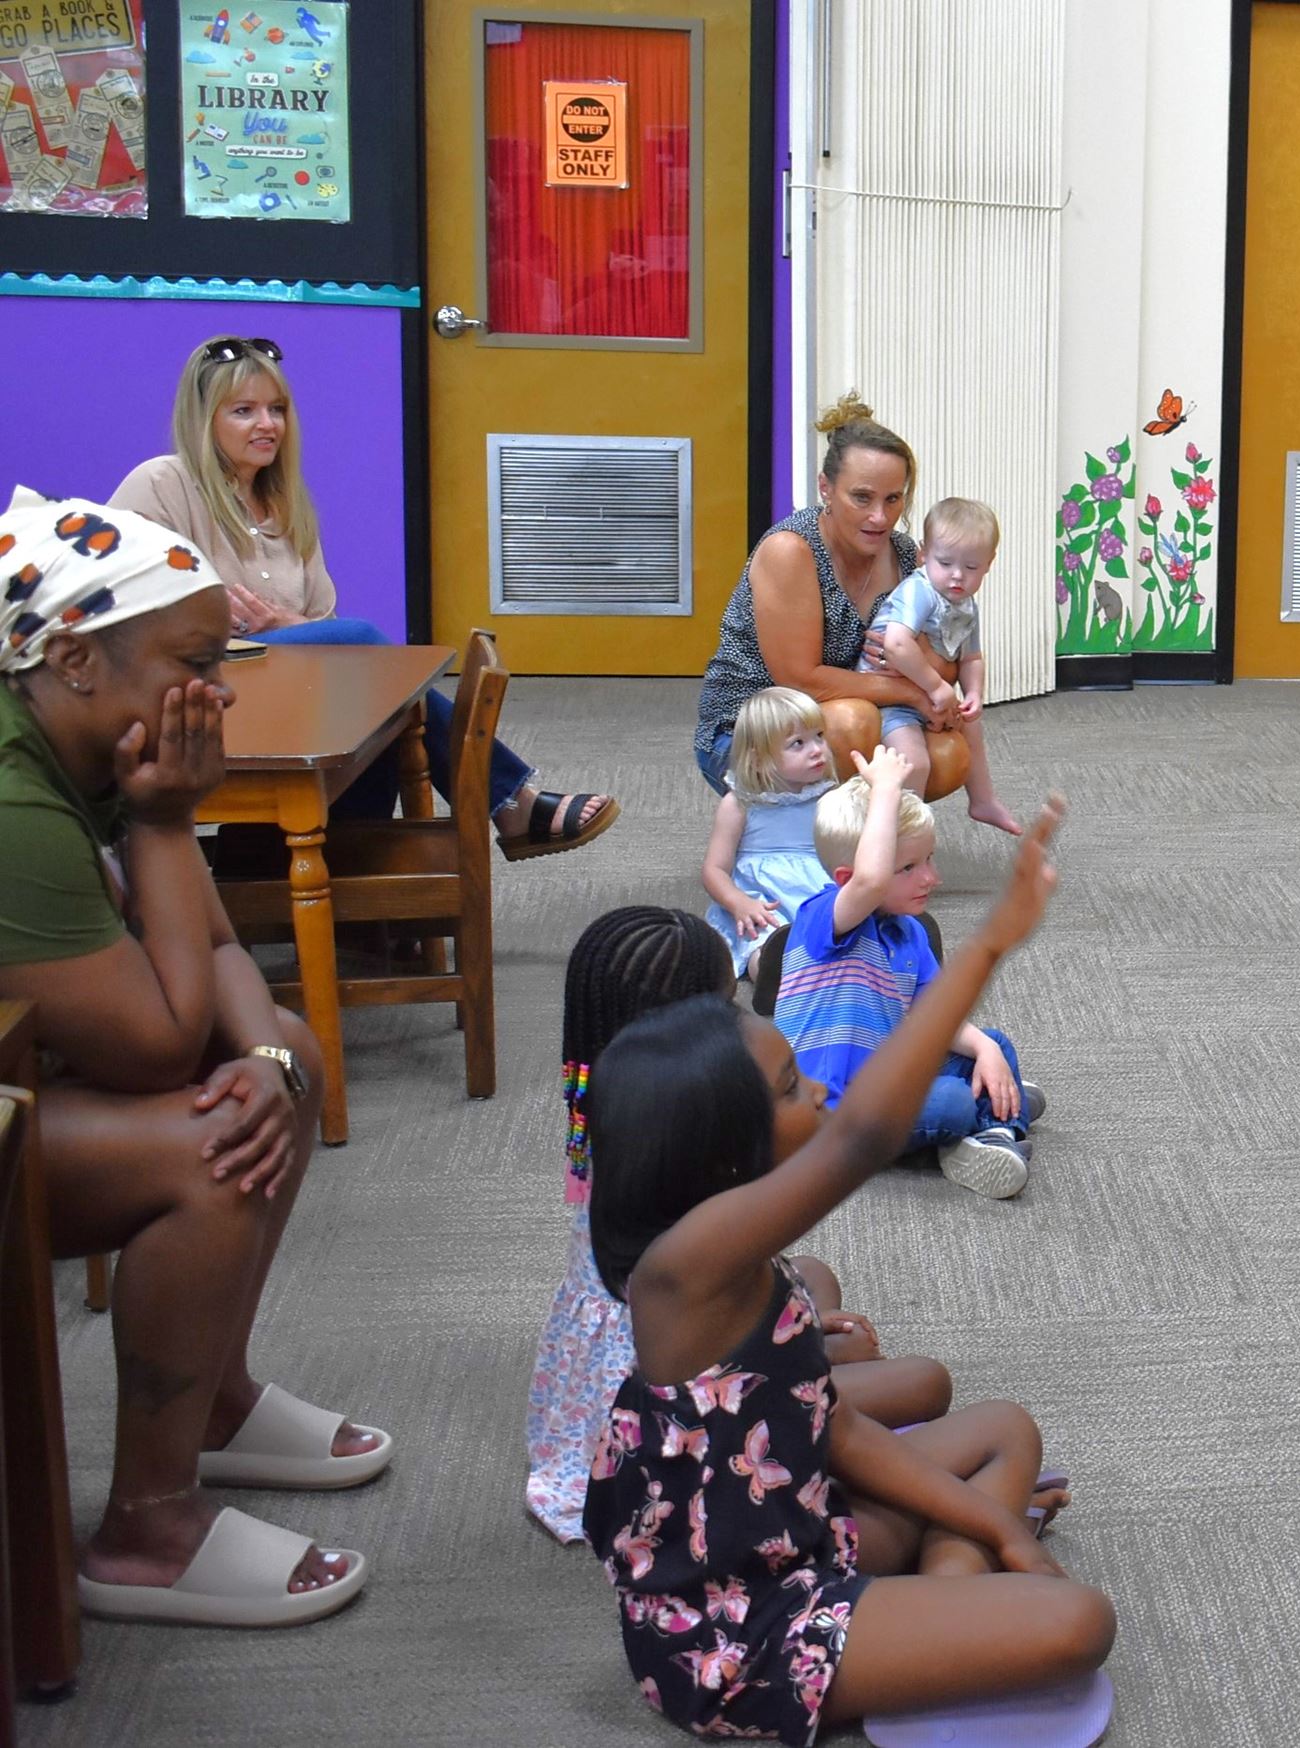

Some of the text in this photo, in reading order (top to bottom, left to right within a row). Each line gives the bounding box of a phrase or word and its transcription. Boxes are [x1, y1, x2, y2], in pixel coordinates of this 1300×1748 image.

[43, 4, 50, 18] A
[59, 0, 95, 16] BOOK
[0, 12, 121, 49] GO PLACES
[198, 85, 329, 112] LIBRARY
[566, 105, 606, 116] DO NOT
[568, 124, 604, 135] ENTER
[253, 134, 288, 145] CAN BE
[559, 148, 615, 162] STAFF
[562, 163, 611, 177] ONLY
